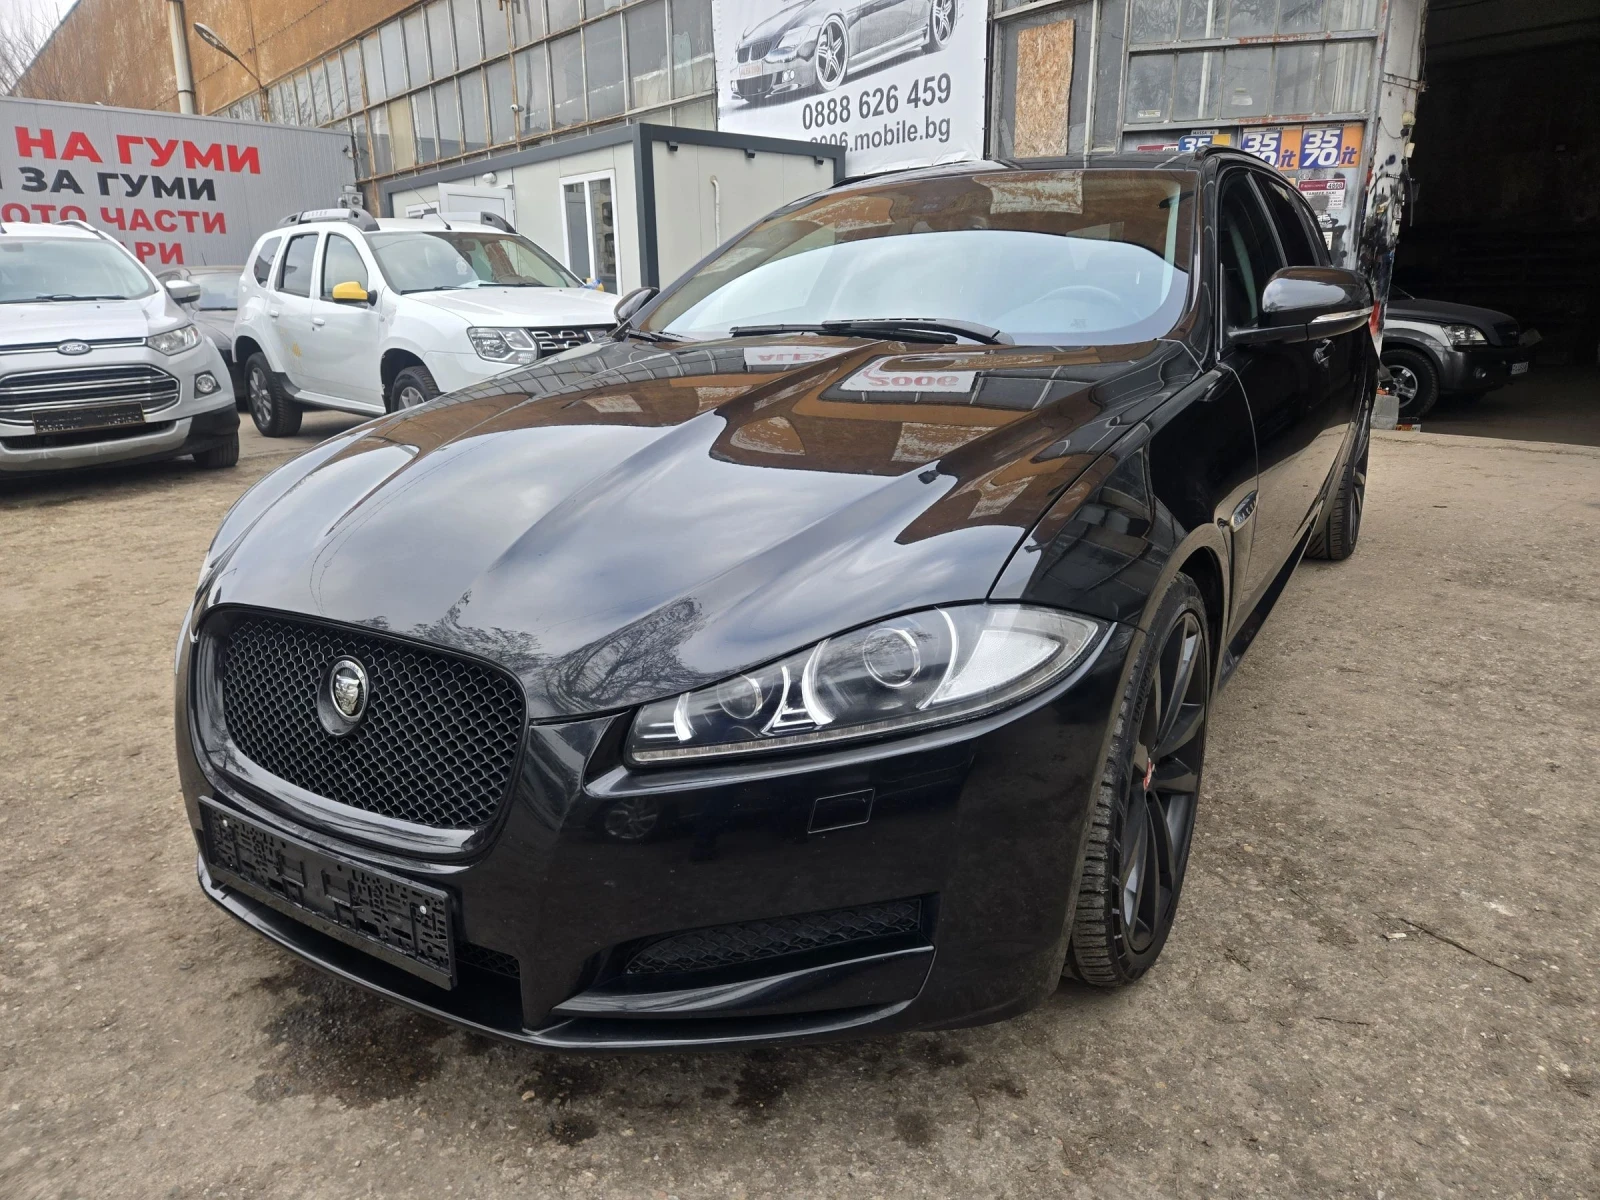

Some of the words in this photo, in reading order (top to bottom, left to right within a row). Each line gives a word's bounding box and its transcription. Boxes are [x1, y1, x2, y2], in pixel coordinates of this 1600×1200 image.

[802, 95, 850, 130] 0888
[858, 84, 899, 119] 626
[907, 72, 952, 110] 459
[810, 116, 951, 152] 06.mobile.bg
[1181, 137, 1211, 151] 35
[1244, 132, 1280, 152] 35
[1304, 129, 1341, 148] 35
[14, 126, 103, 164] НА
[115, 134, 261, 175] ГУМИ
[18, 166, 85, 195] ЗА
[96, 171, 217, 202] ГУМИ
[99, 206, 227, 235] ЧАСТИ
[122, 240, 185, 266] РИ
[66, 344, 83, 352] Ford
